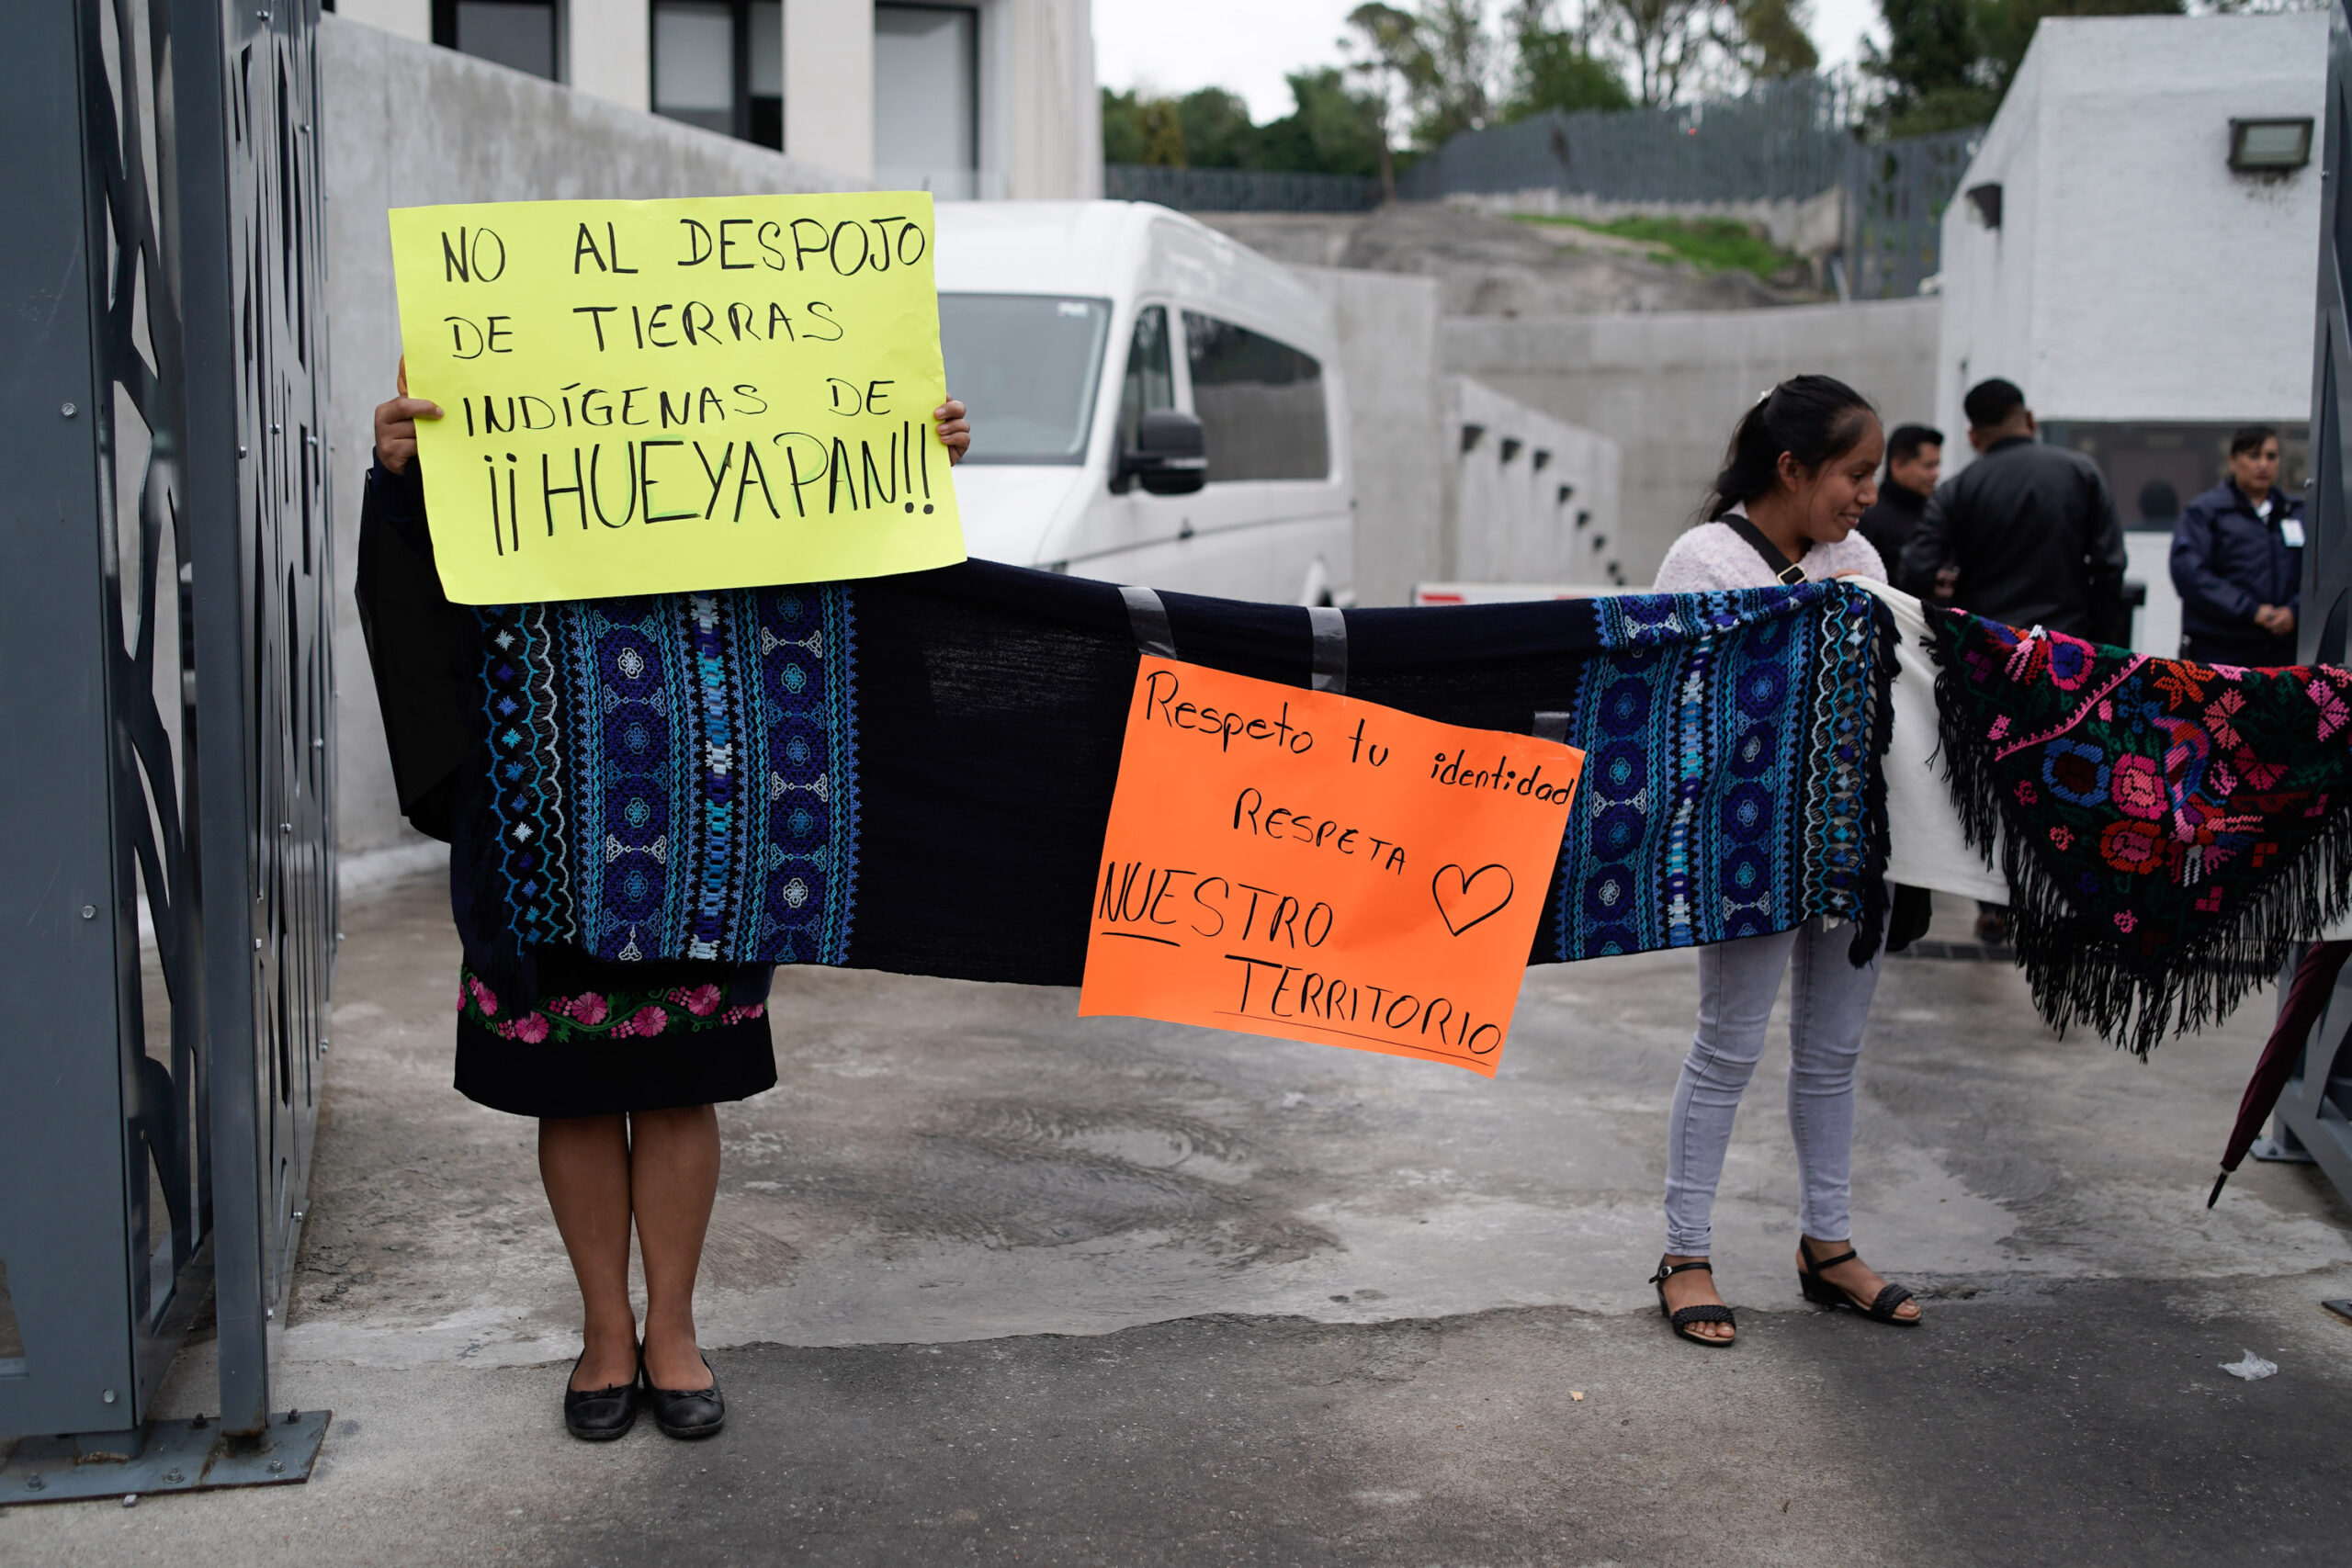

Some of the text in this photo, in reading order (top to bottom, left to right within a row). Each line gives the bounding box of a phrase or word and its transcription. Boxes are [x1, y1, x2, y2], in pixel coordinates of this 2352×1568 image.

[442, 217, 925, 283] NO AL DESPOJO
[445, 301, 843, 359] DE TIERRAS
[463, 378, 895, 436] INDÍGENAS DE
[1147, 670, 1575, 806] Respeto tu identidad
[1234, 788, 1406, 874] RESPETA
[1099, 860, 1333, 949] NUESTRO
[1225, 954, 1501, 1055] TERRITORIO
